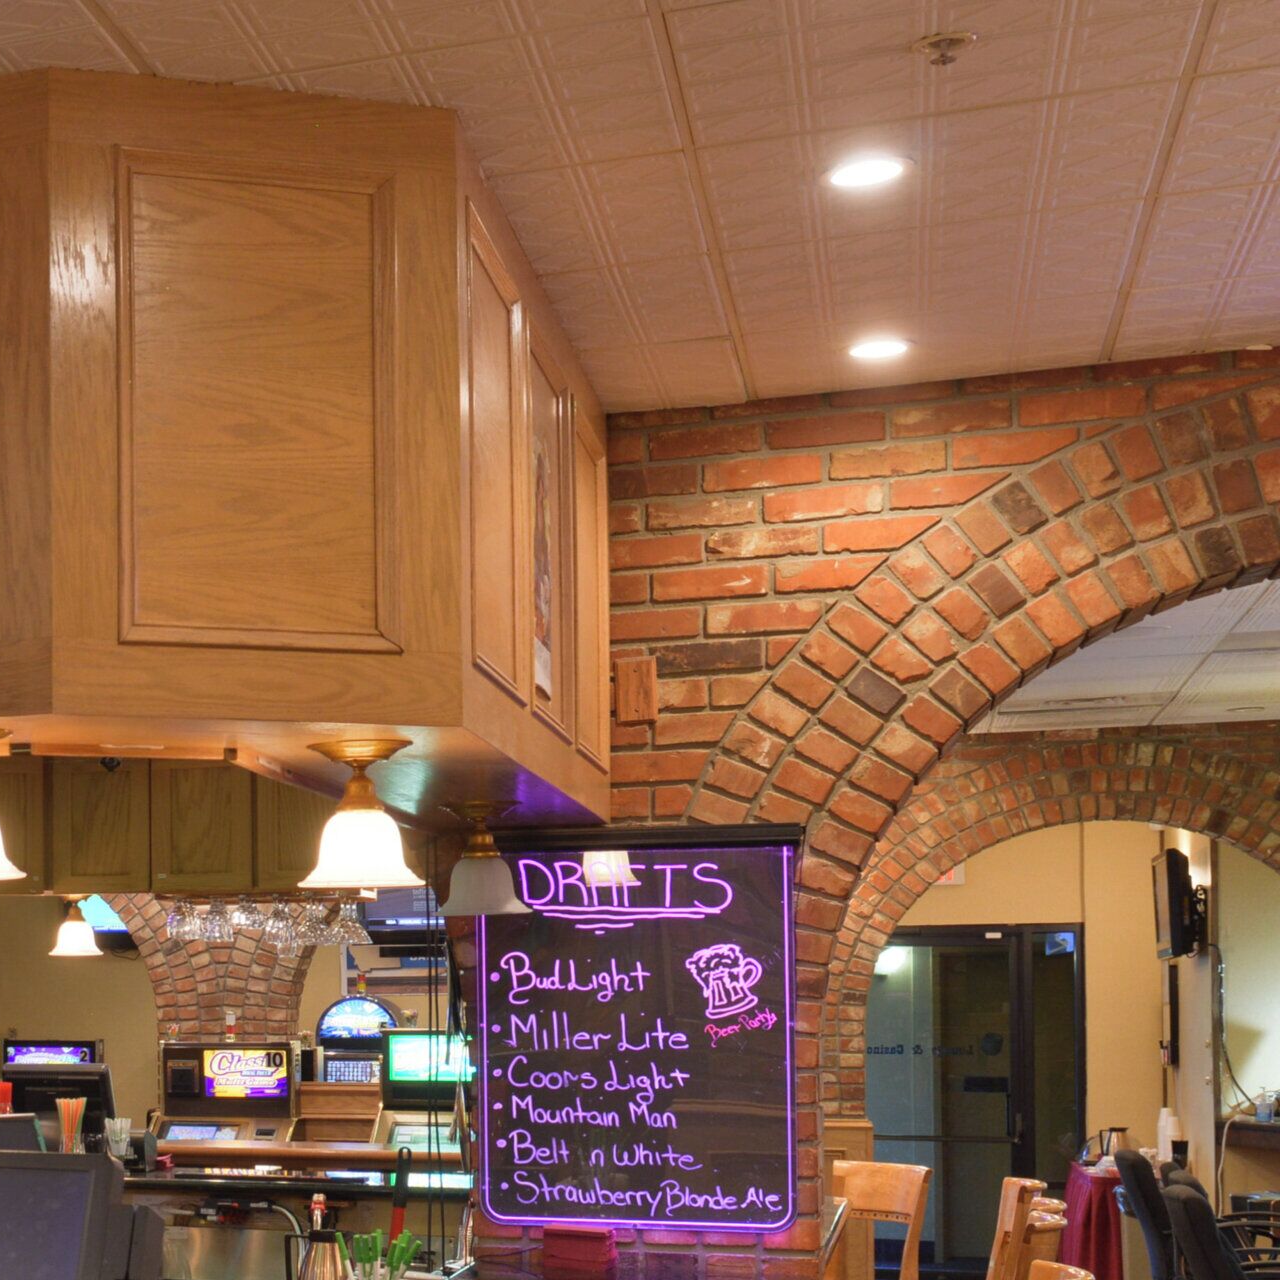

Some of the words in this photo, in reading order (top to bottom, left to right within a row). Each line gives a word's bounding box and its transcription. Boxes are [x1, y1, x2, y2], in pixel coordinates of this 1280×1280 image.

[518, 858, 734, 910] DRAFTS
[502, 1010, 611, 1052] Miller
[617, 1012, 690, 1052] Lite
[704, 1023, 742, 1048] Beer
[265, 1051, 284, 1068] 10
[507, 1055, 599, 1091] Coors
[605, 1060, 691, 1103] Light
[511, 1095, 620, 1128] Mountain
[629, 1100, 678, 1129] Man
[508, 1129, 570, 1166] Belt
[589, 1148, 606, 1167] n
[612, 1140, 703, 1170] White
[513, 1171, 661, 1217] Strawberry
[660, 1180, 738, 1216] Blonde
[741, 1186, 783, 1212] Ale
